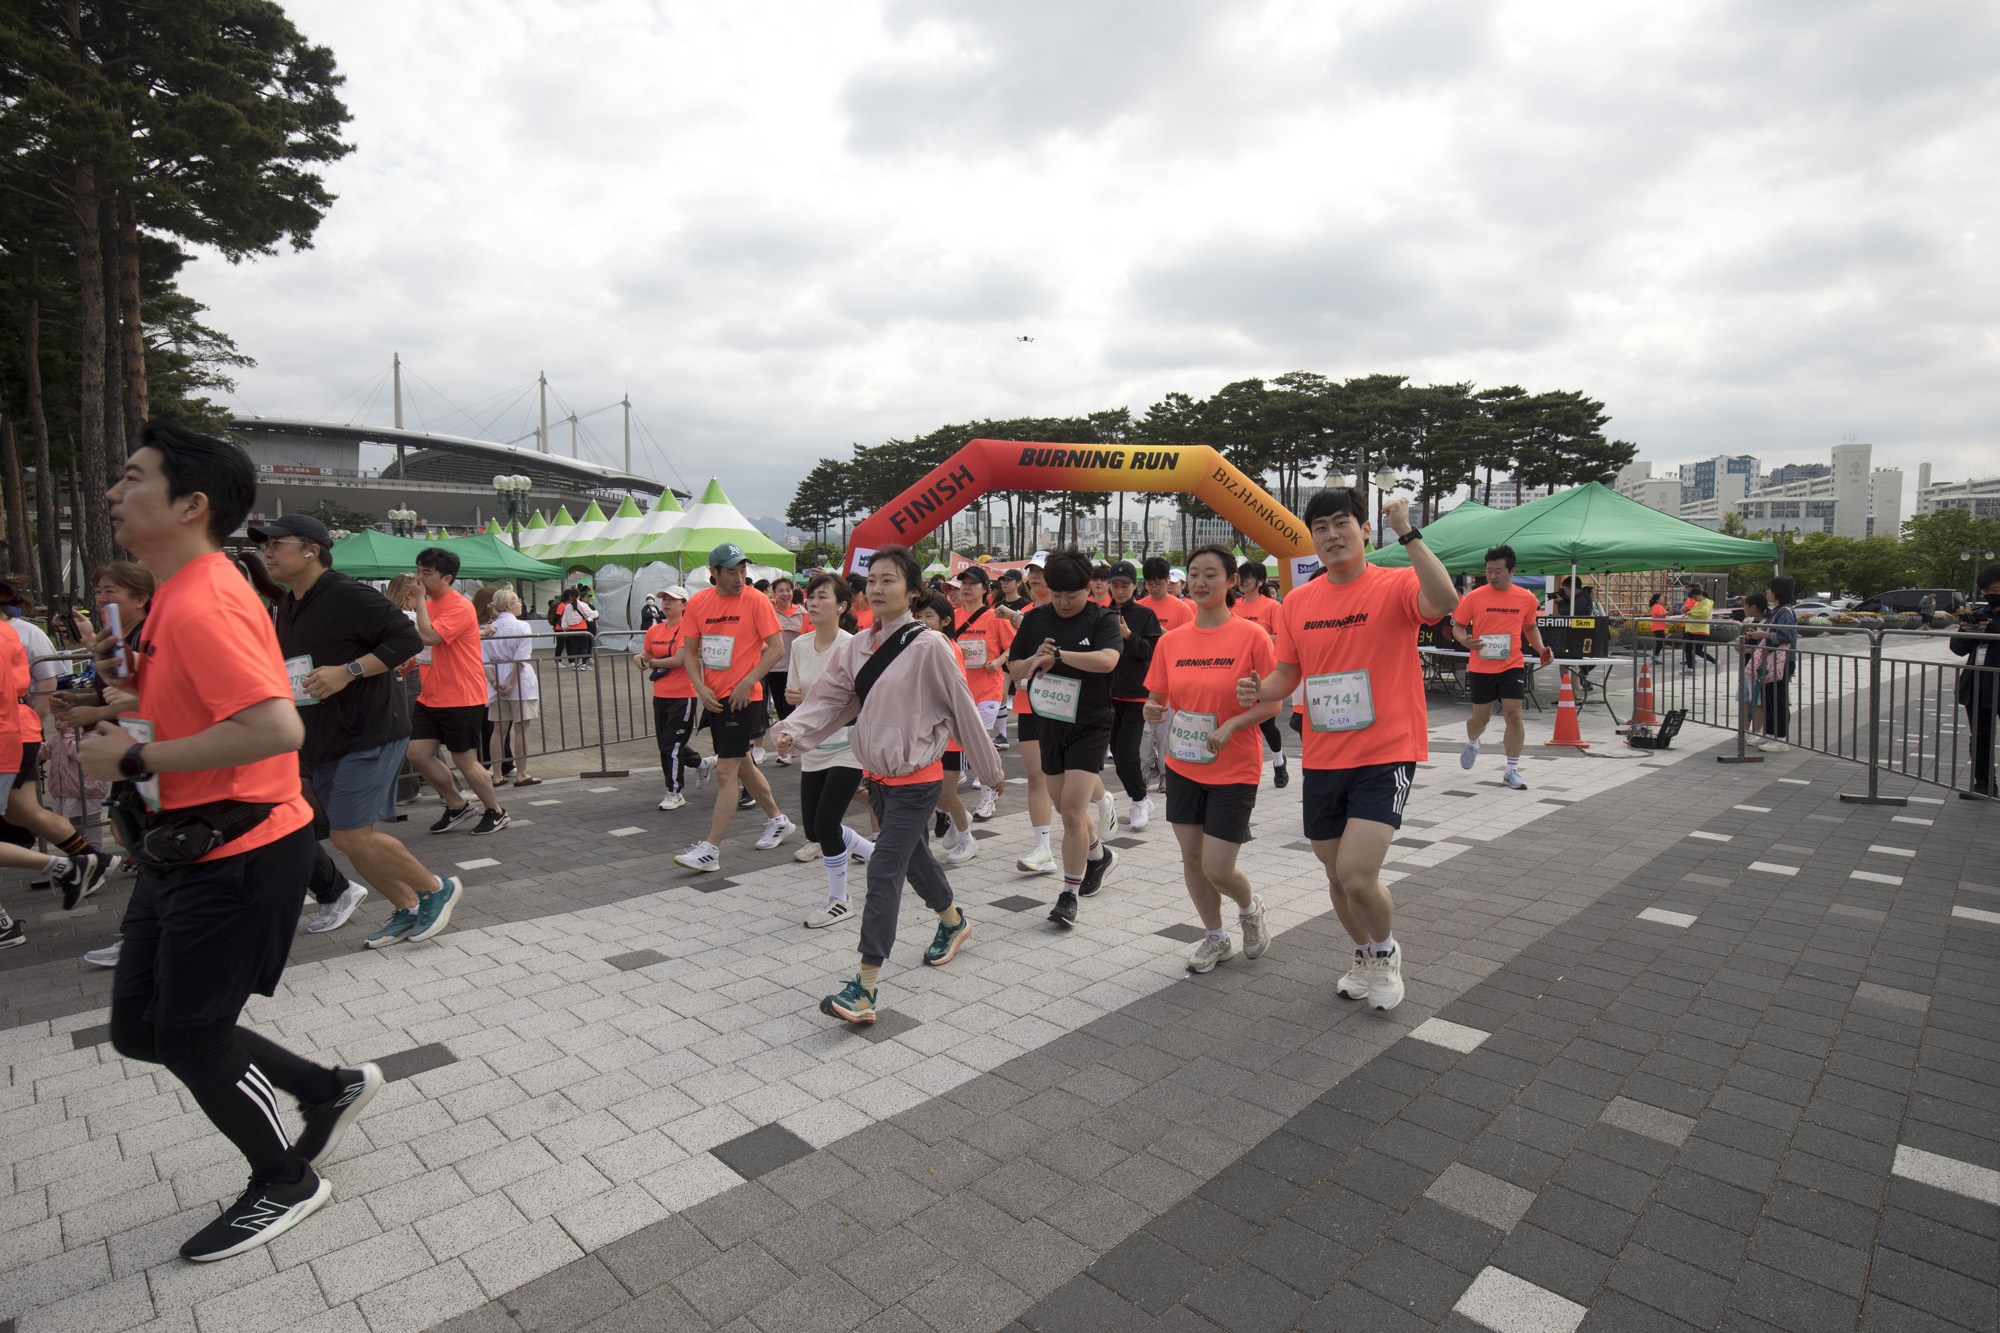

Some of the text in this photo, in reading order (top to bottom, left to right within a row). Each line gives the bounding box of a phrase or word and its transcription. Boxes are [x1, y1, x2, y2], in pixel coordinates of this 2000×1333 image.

[1018, 448, 1179, 470] BURNING RUN
[889, 464, 975, 535] FINISH
[707, 647, 728, 656] 7167
[1175, 658, 1235, 667] BURNING RUN
[1041, 690, 1071, 703] 8403
[1323, 692, 1360, 706] 7141
[1176, 728, 1208, 741] 8248
[1178, 750, 1195, 758] C-575
